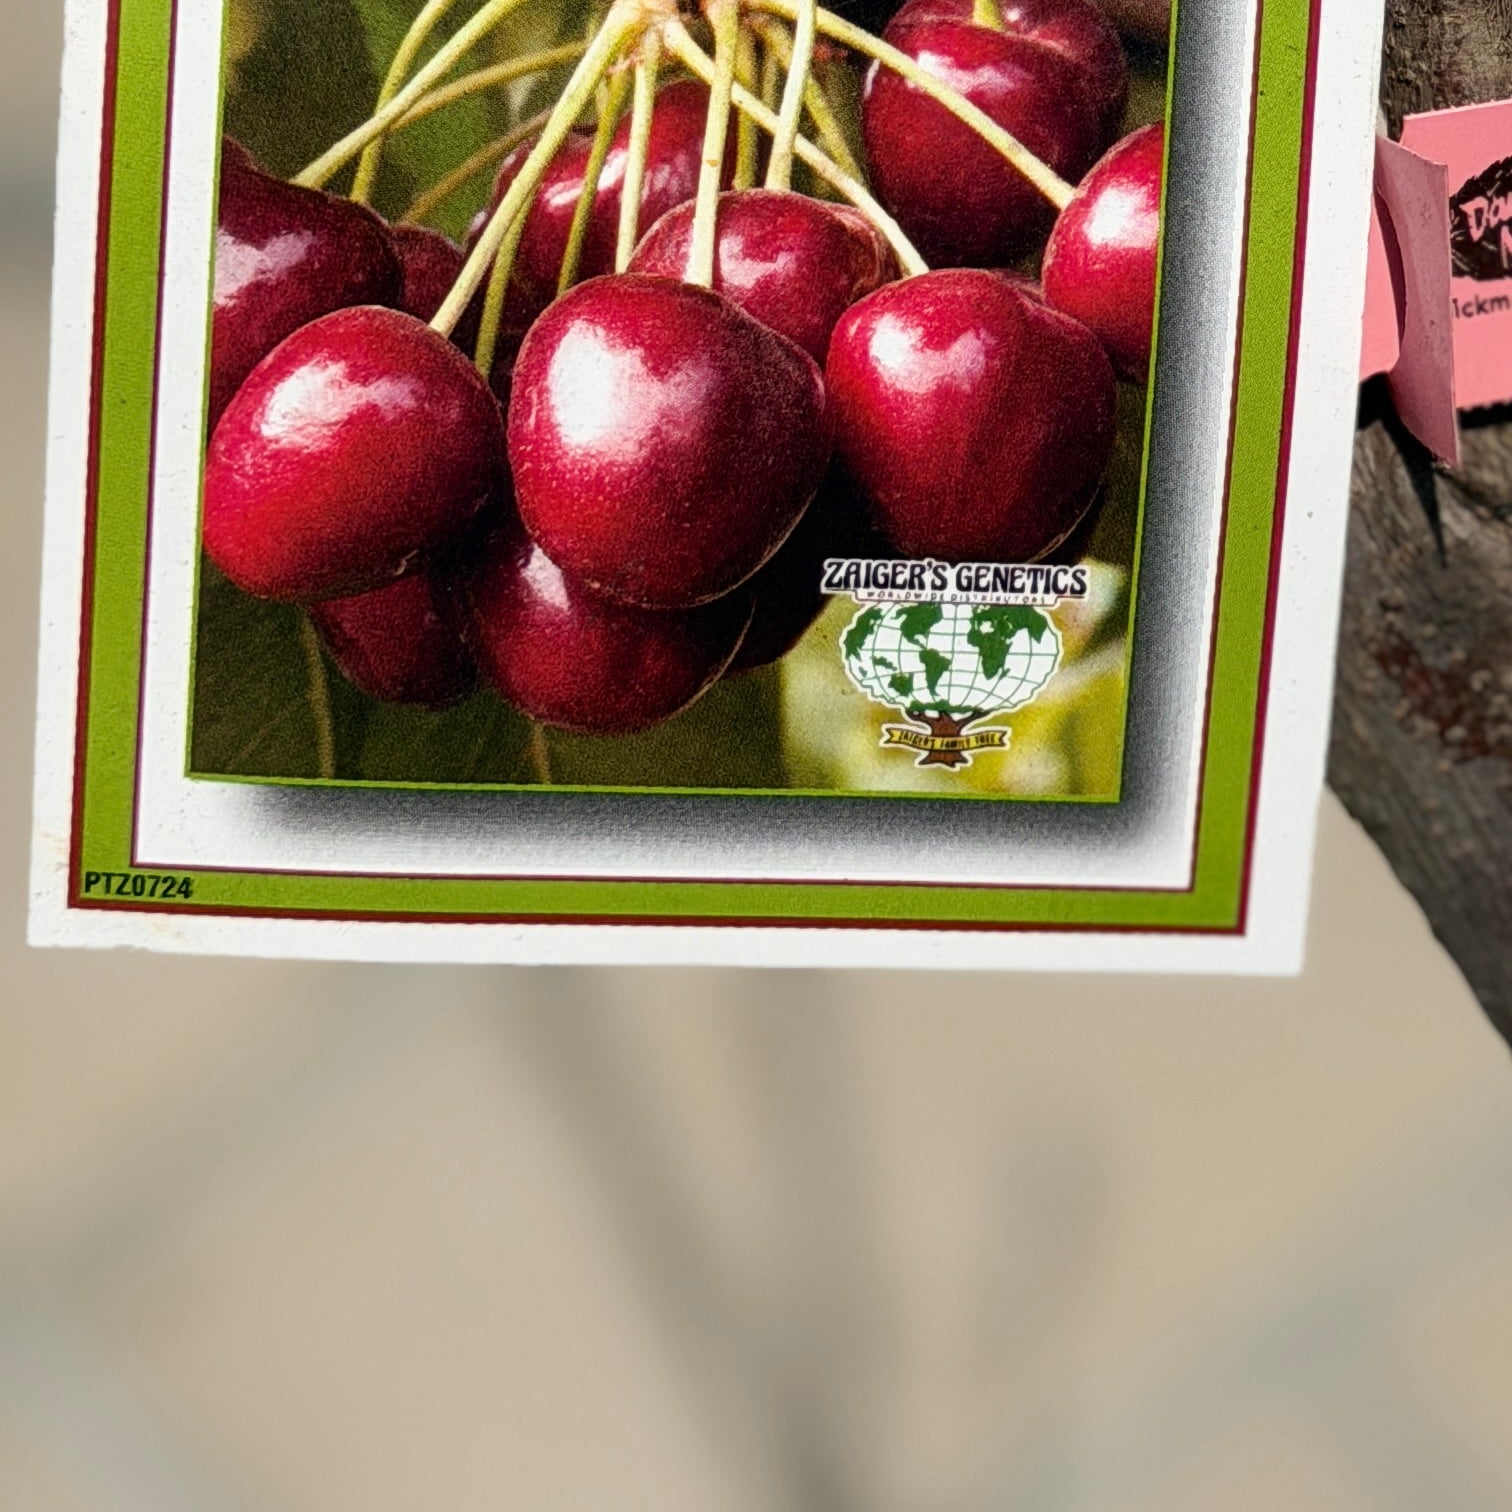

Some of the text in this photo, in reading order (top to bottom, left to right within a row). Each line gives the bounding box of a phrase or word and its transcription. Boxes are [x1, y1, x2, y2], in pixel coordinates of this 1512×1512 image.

[824, 560, 1087, 595] ZAIGER'S GENETICS
[84, 870, 193, 899] PTZ0724
